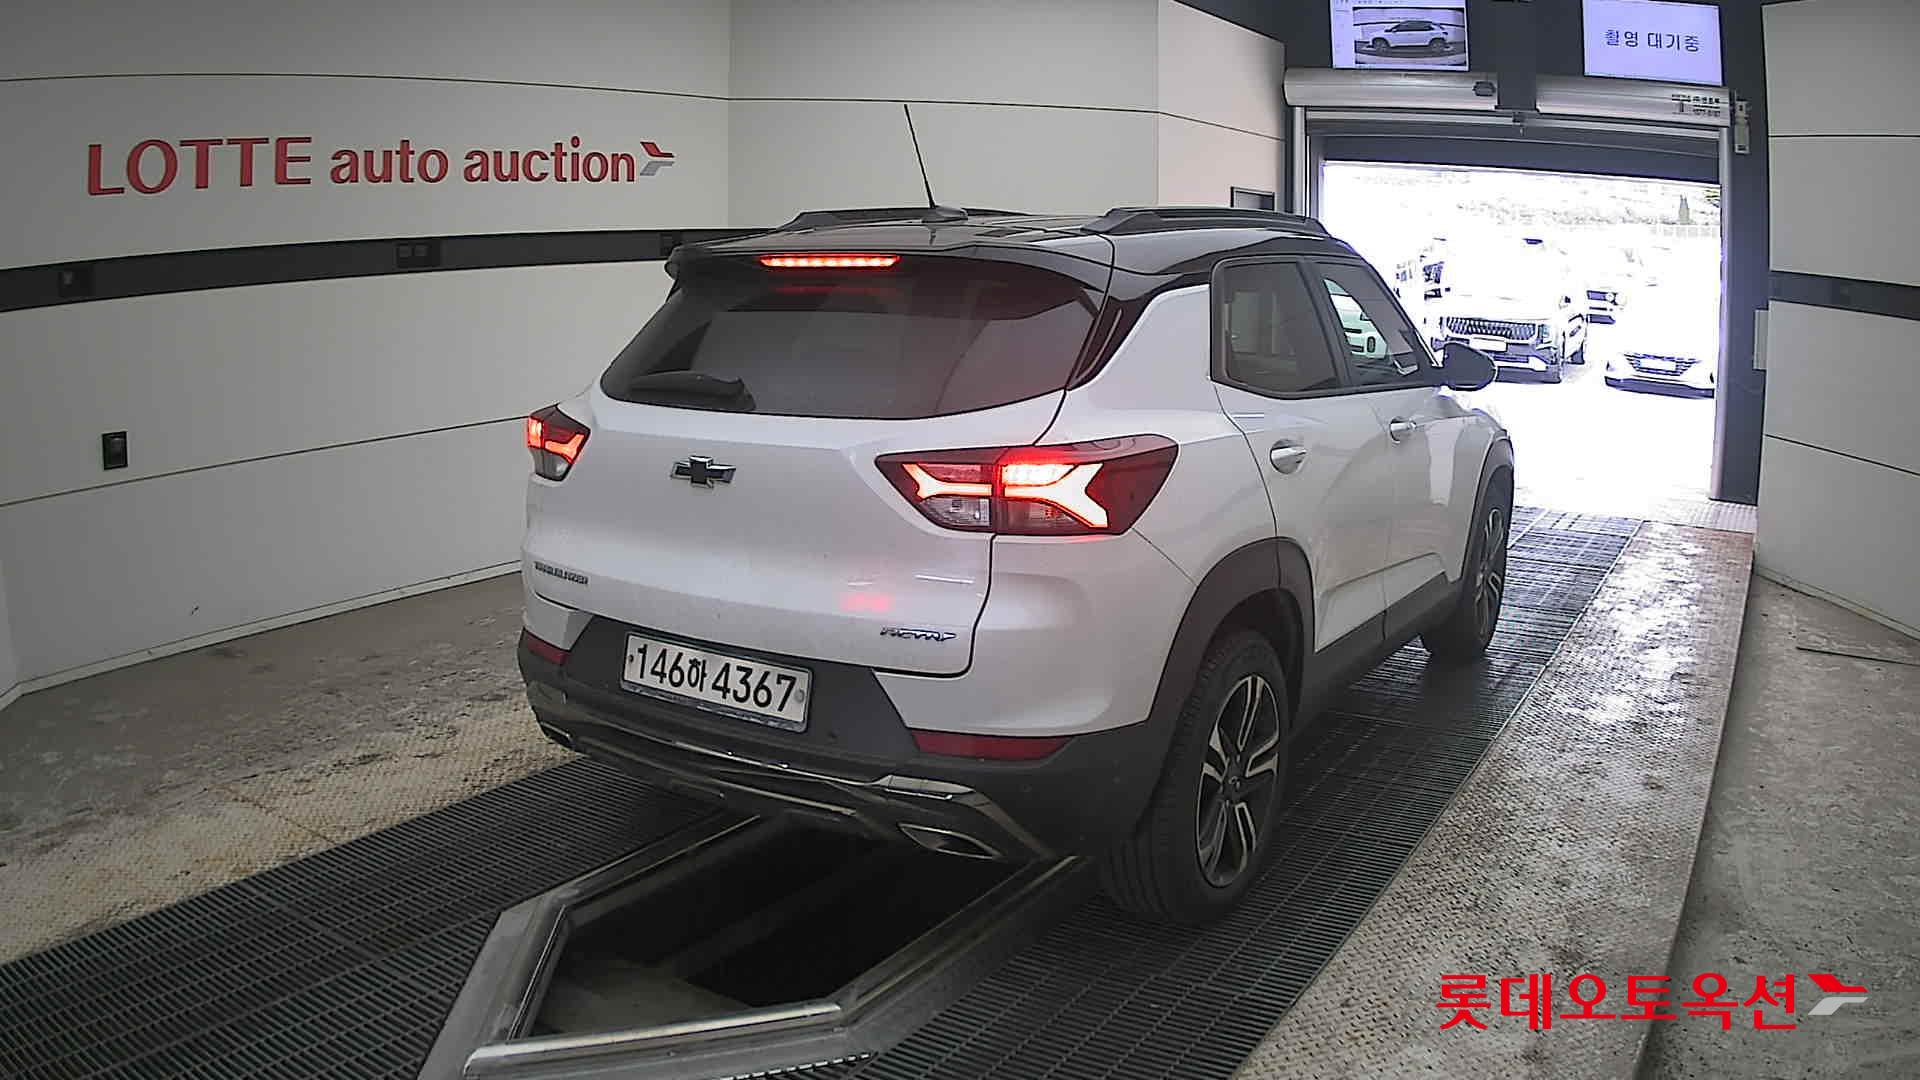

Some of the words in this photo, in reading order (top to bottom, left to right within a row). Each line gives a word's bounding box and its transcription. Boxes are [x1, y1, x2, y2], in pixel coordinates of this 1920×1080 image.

[1647, 32, 1699, 52] 대기중
[87, 136, 313, 196] LOTTE
[330, 139, 449, 184] auto
[463, 135, 637, 184] auction
